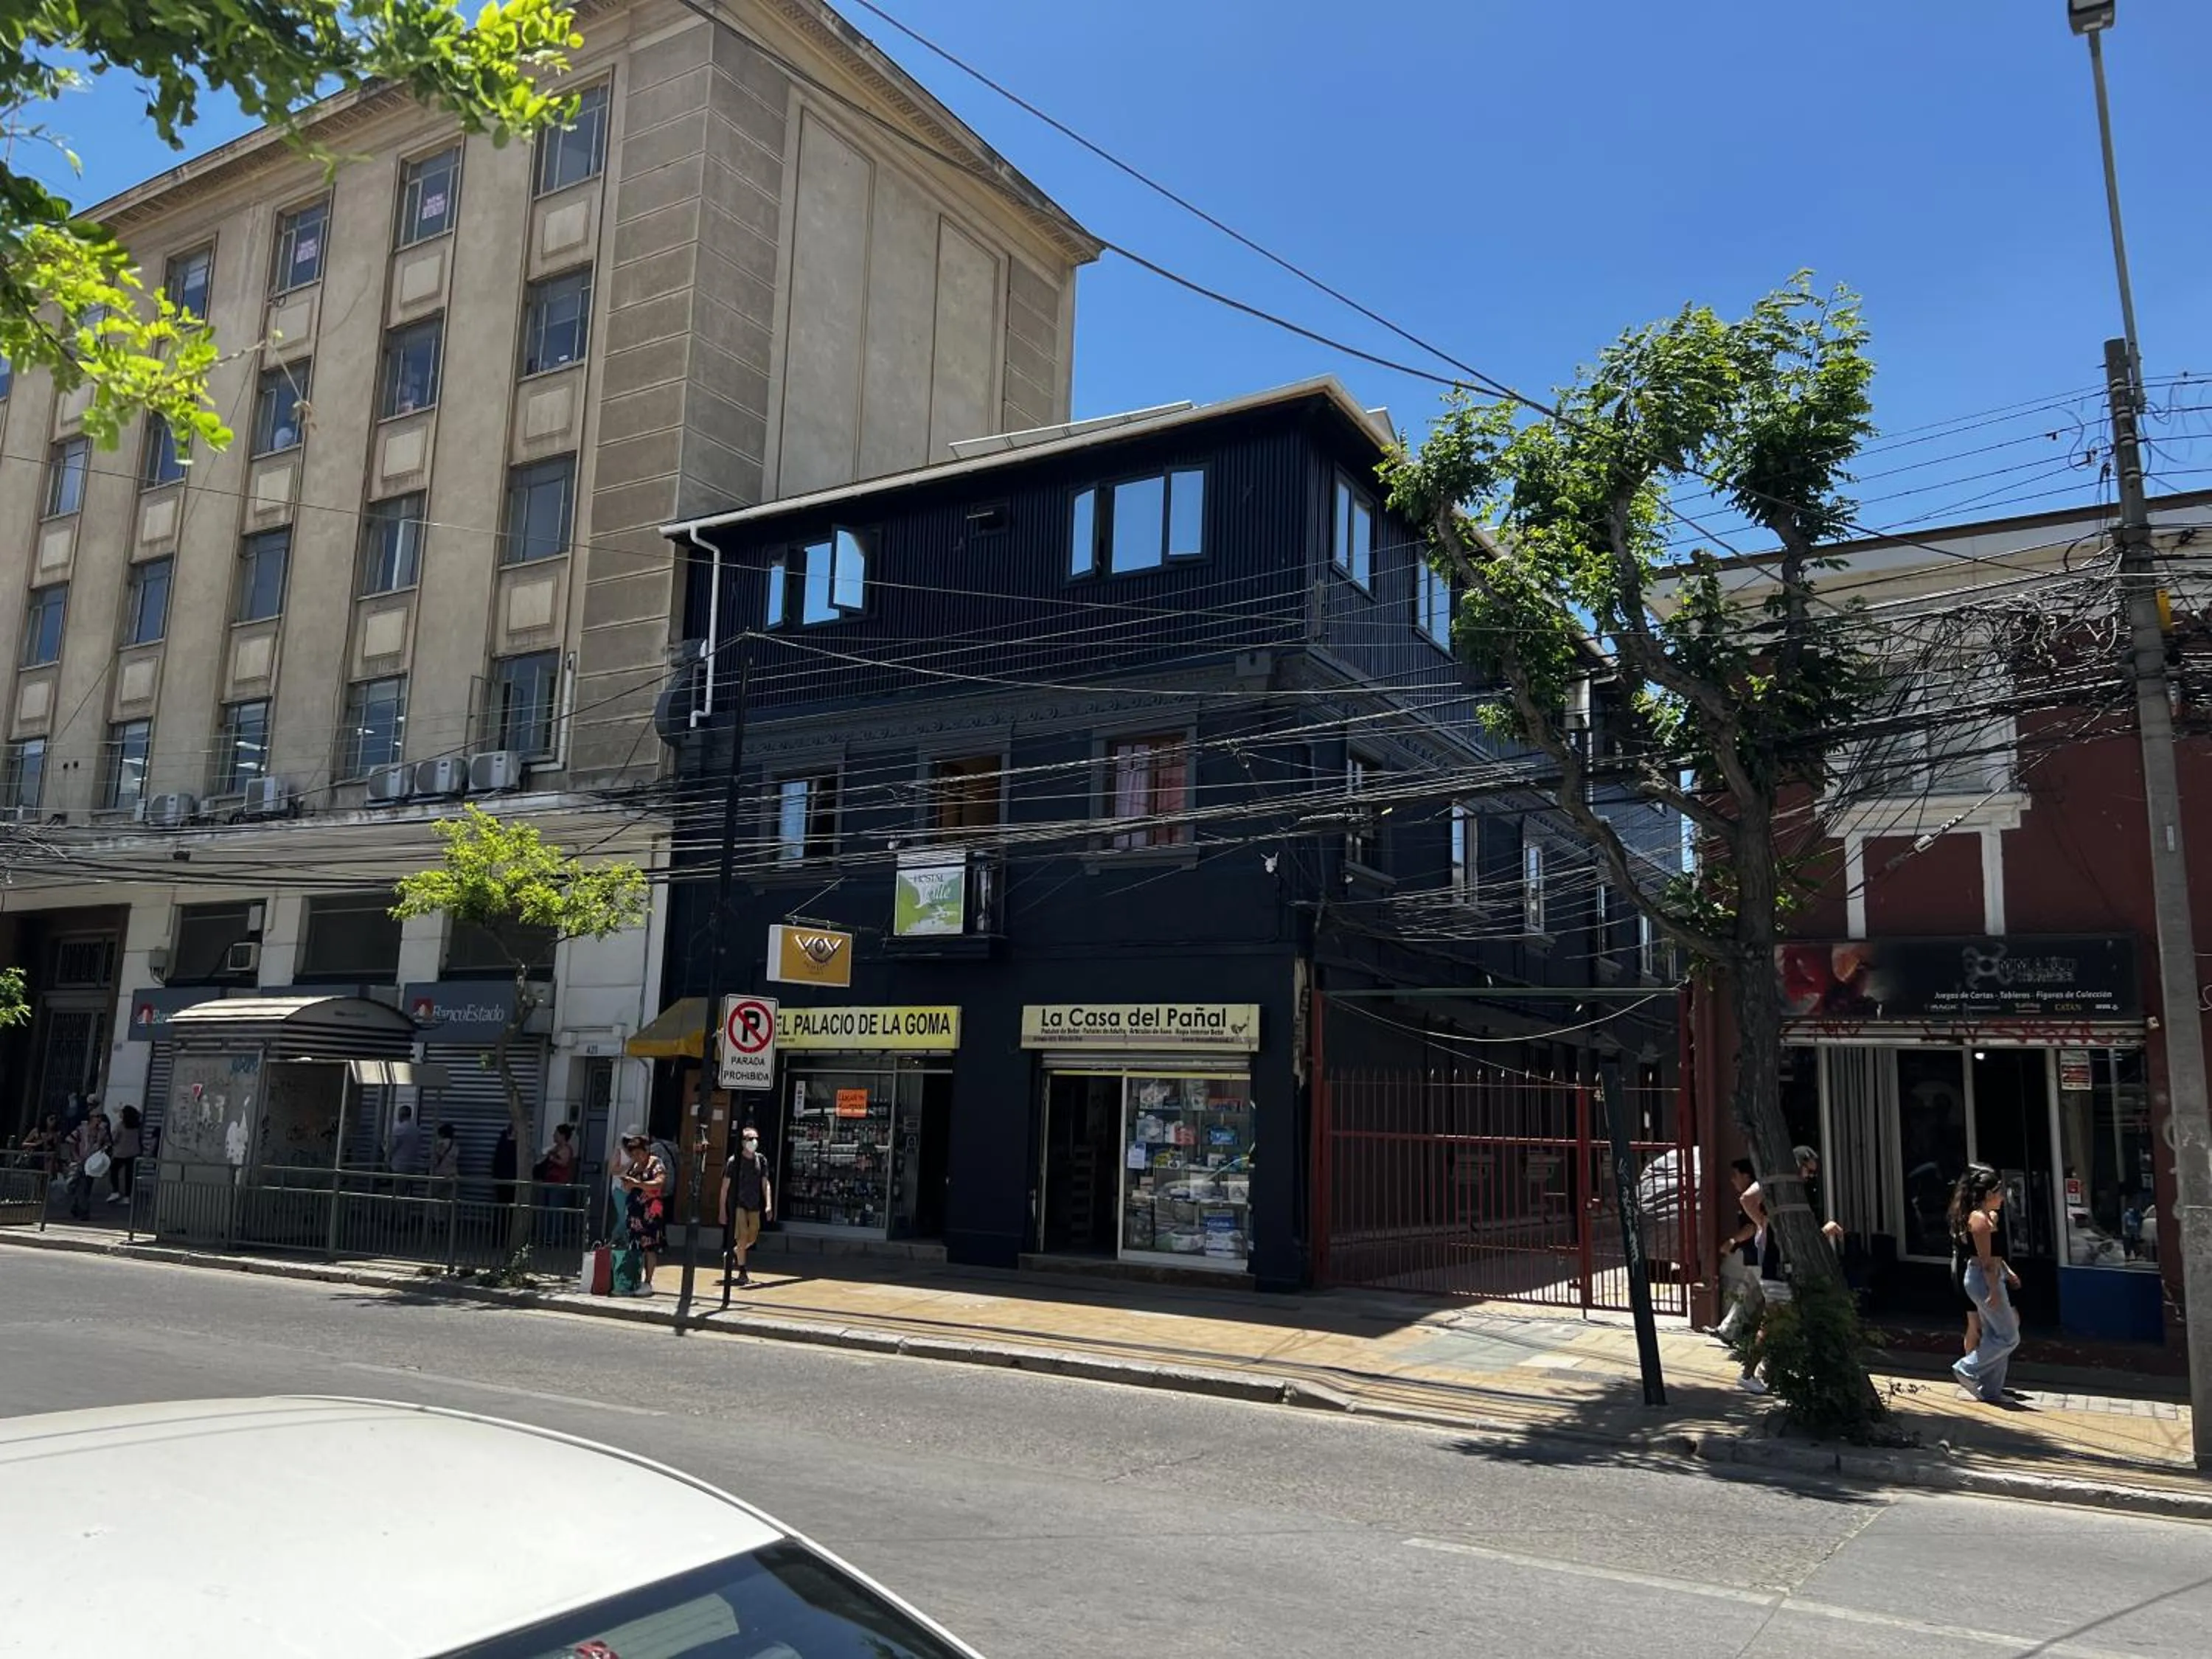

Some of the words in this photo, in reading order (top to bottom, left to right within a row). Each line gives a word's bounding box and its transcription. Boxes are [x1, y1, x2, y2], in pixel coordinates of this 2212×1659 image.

[1934, 991, 1958, 1001] Juegos
[1959, 991, 1969, 999] de
[1969, 991, 1994, 999] Cartas
[1999, 991, 2030, 1000] Tableros
[2036, 990, 2064, 1001] Figuras
[2065, 990, 2074, 998] de
[1041, 1008, 1062, 1027] La
[1069, 1008, 1121, 1027] Casa
[1127, 1007, 1160, 1027] del
[1167, 1007, 1226, 1027] Pañal
[794, 1013, 854, 1035] PALACIO
[859, 1013, 877, 1034] DE
[883, 1013, 900, 1034] LA
[905, 1012, 950, 1034] GOMA
[731, 1056, 765, 1065] PARADA
[723, 1070, 769, 1081] PROHIBIDA
